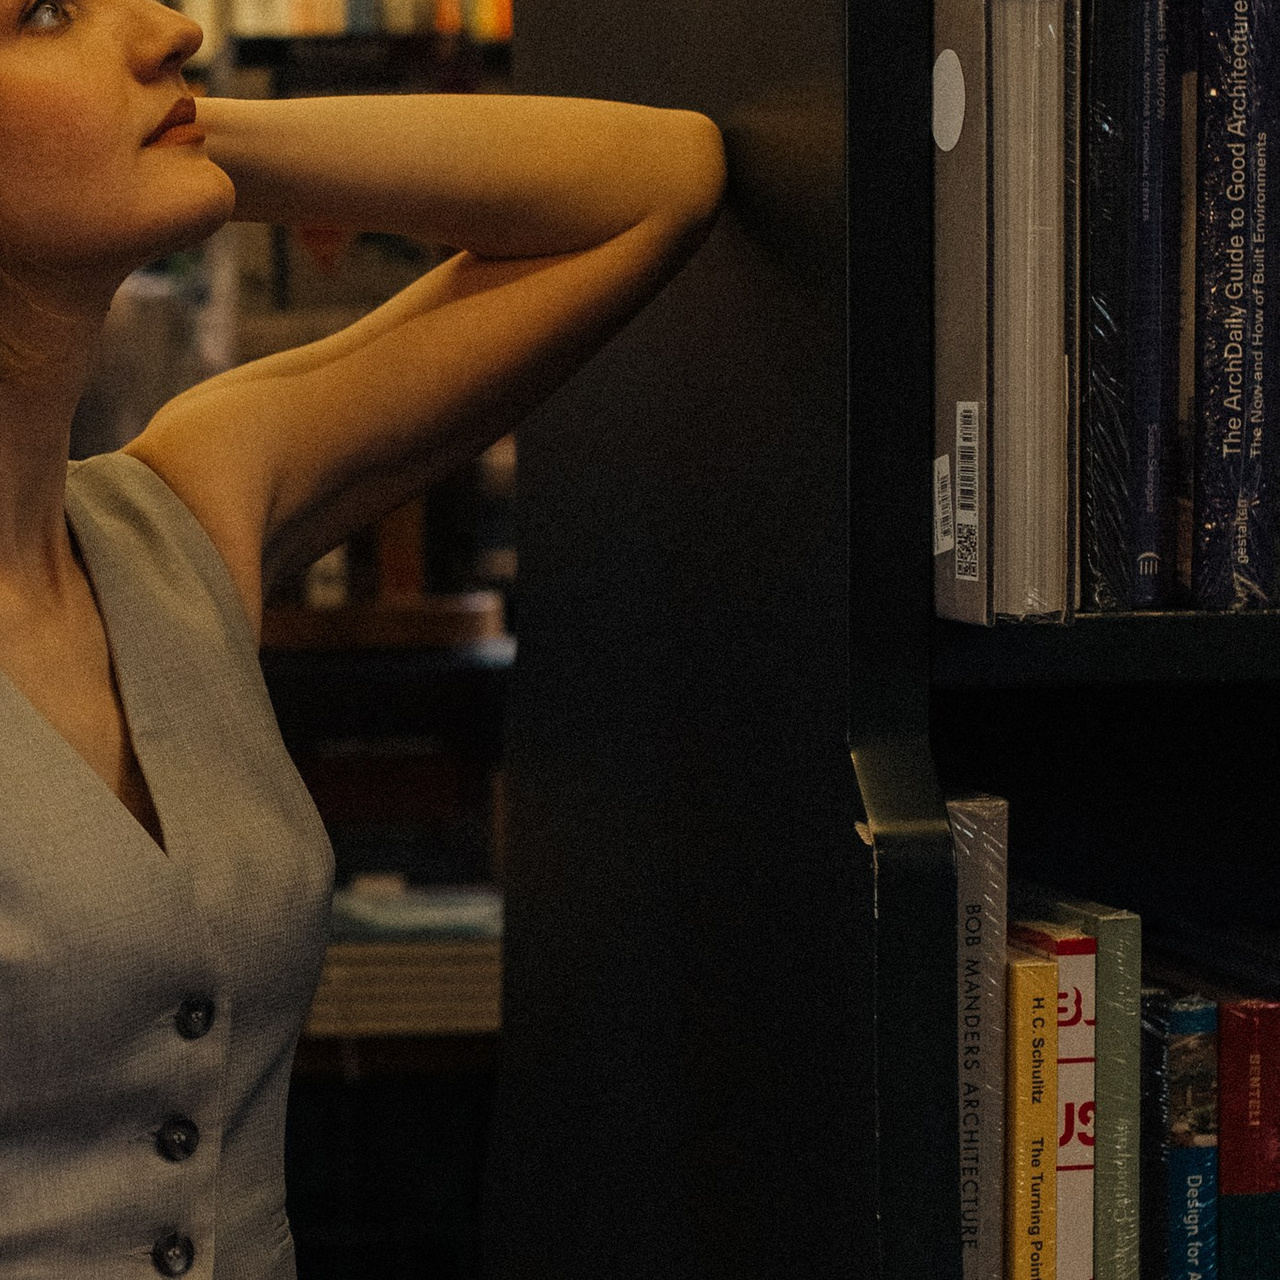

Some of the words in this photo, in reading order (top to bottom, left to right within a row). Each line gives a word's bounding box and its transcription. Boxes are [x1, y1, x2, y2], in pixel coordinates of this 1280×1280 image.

[1157, 46, 1168, 122] Tomorrow
[1226, 142, 1247, 201] Good
[1252, 132, 1268, 243] Environments
[1227, 208, 1246, 228] to
[1225, 235, 1246, 300] Guide
[1252, 247, 1265, 283] Built
[1251, 287, 1265, 305] of
[1251, 308, 1264, 345] How
[1223, 304, 1247, 411] ArchDaily
[1250, 351, 1263, 381] and
[1250, 385, 1263, 422] Now
[1222, 416, 1242, 458] The
[1249, 428, 1262, 458] The
[965, 904, 981, 947] BOB
[964, 959, 981, 1071] MANDERS
[1031, 997, 1045, 1014] H.
[1031, 1017, 1045, 1034] C.
[1031, 1037, 1045, 1104] Schulitz
[1248, 1053, 1260, 1127] BENTELI
[962, 1081, 980, 1249] ARCHITECTURE
[1031, 1137, 1045, 1167] The
[1028, 1172, 1044, 1236] Turning
[1184, 1174, 1203, 1236] Design
[1187, 1241, 1203, 1266] for
